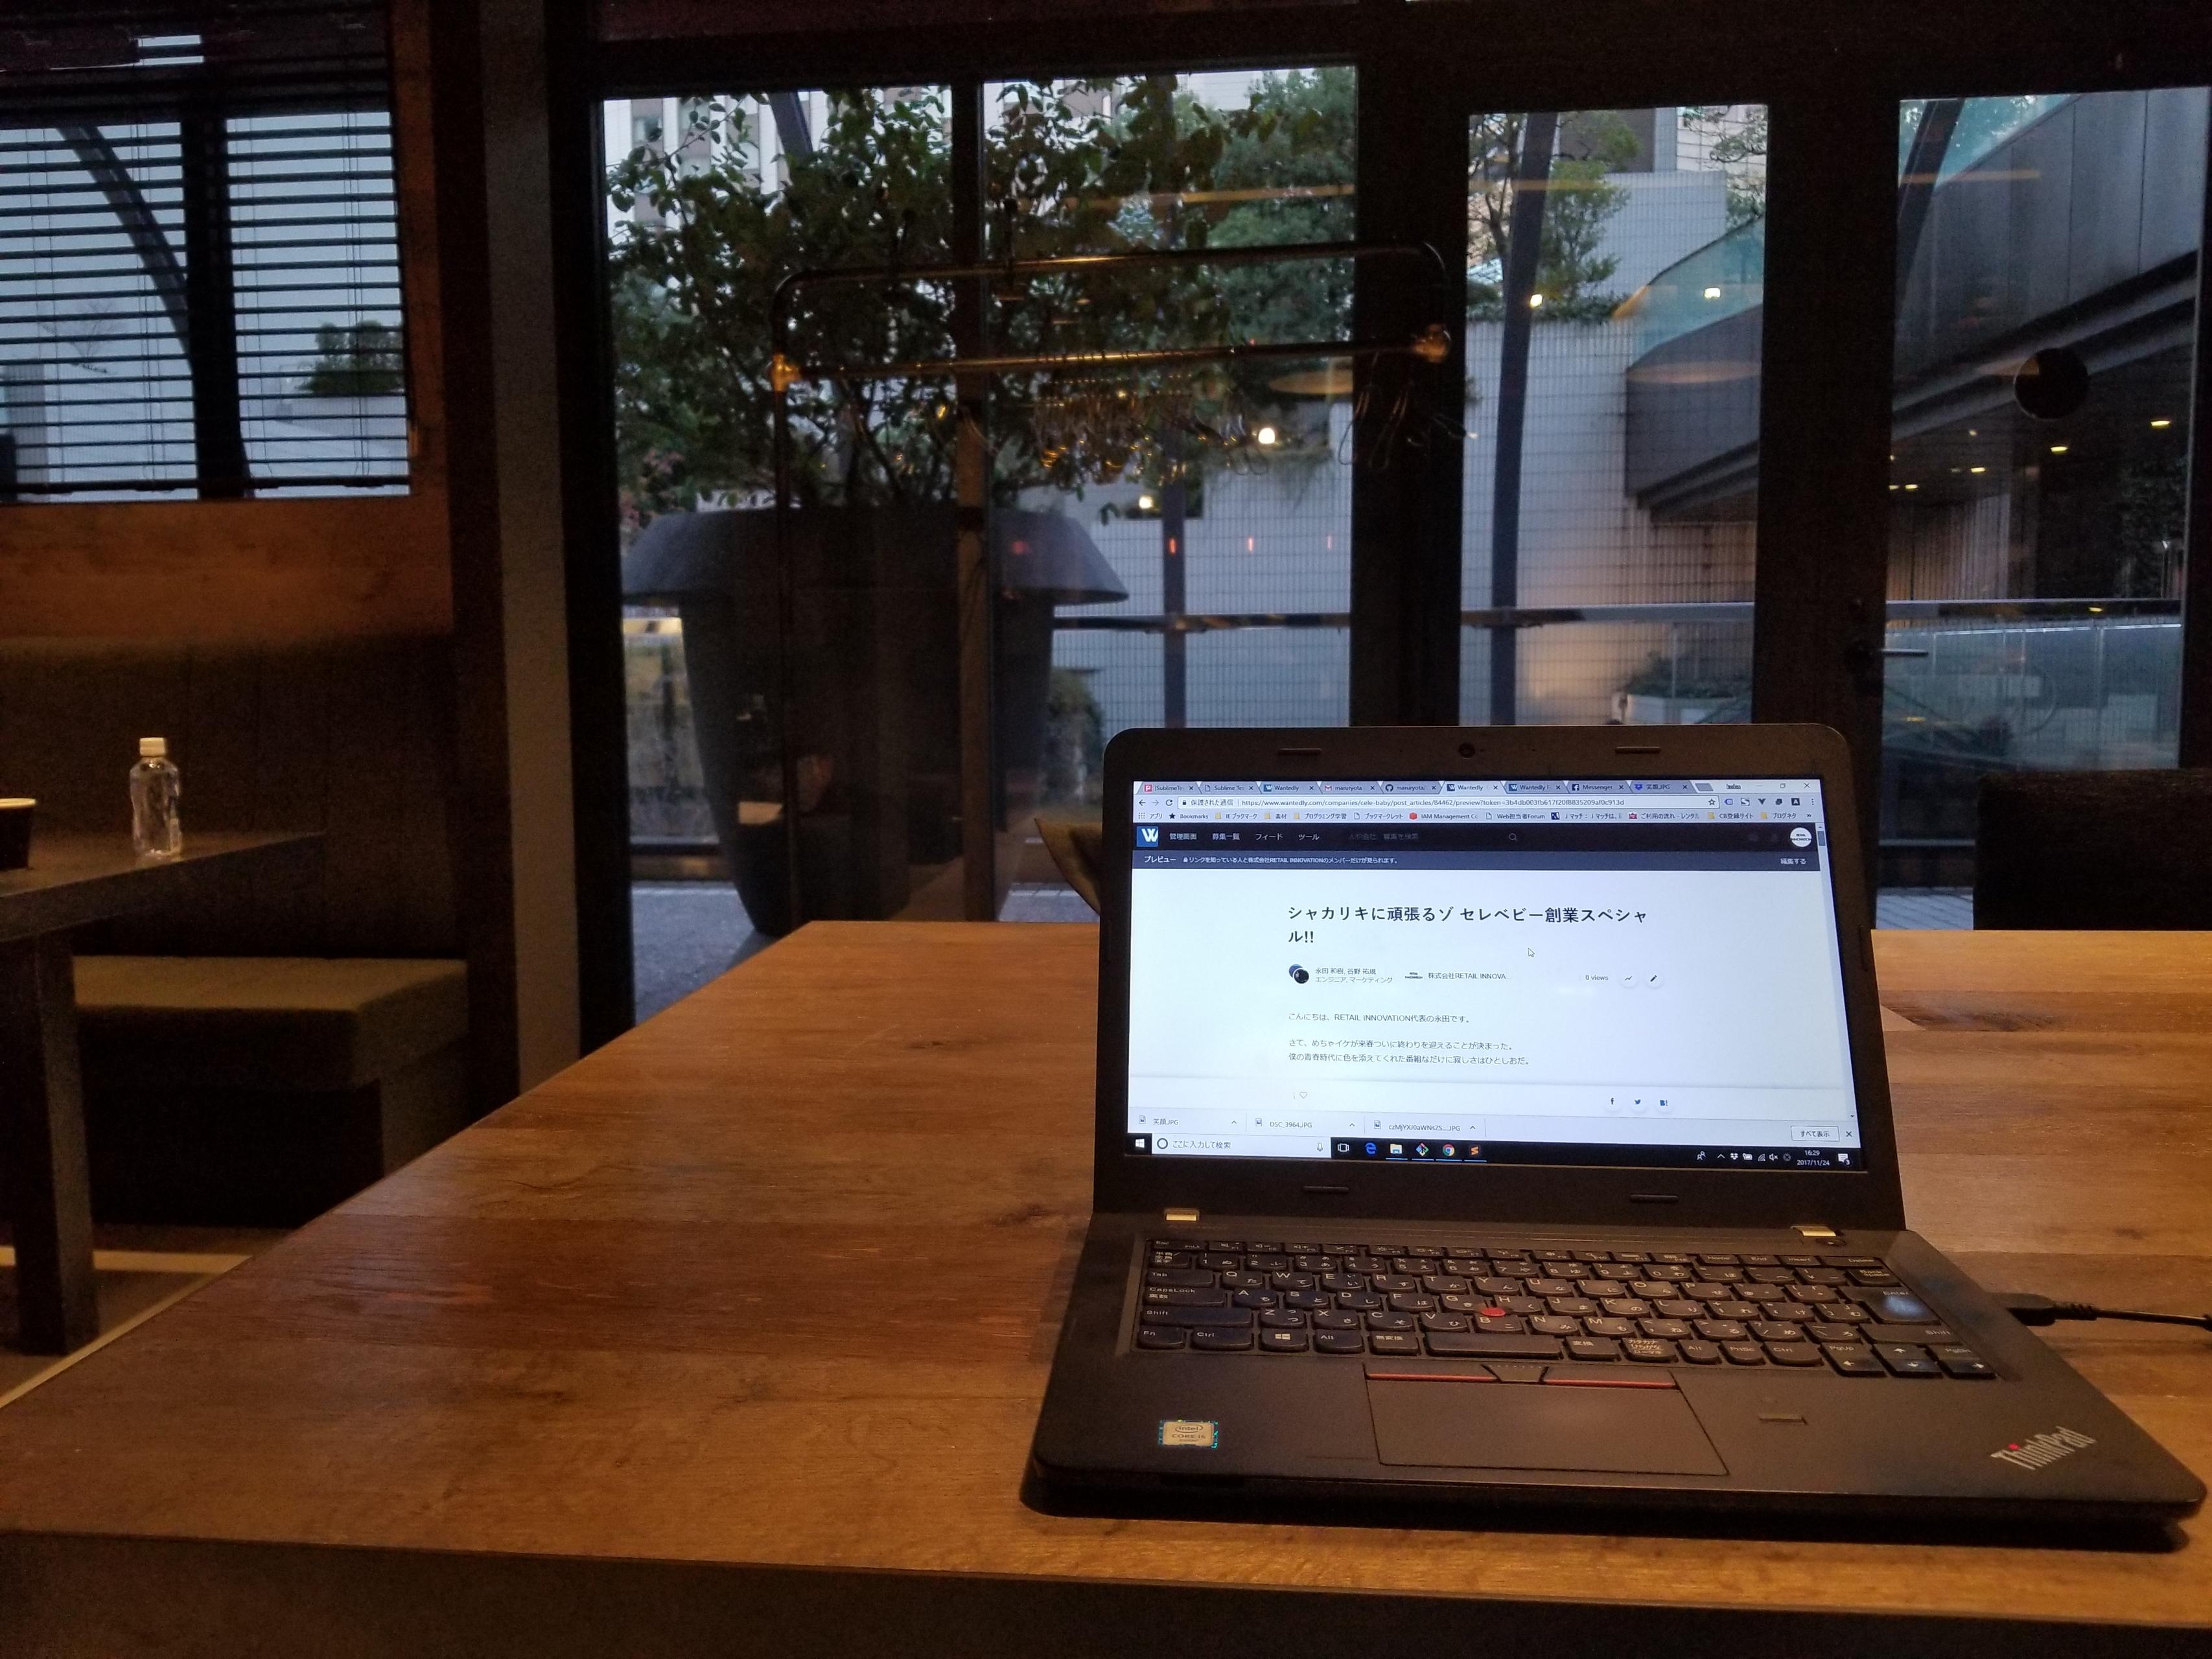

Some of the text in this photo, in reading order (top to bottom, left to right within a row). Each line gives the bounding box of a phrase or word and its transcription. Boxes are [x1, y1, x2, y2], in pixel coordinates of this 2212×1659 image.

[1288, 906, 1646, 923] シャカリキに頑張るゾ セレベビー創業スペシャ
[1363, 1014, 1469, 1023] INNOVATION代表の永田です。
[1288, 1039, 1512, 1050] さて、めちゃイケが来春ついに終わりを迎えることが決まった。
[1289, 1053, 1529, 1065] 僕の青春時代に色を添えてくれた番組なだけに寂しさはひとしおだ。
[1172, 1141, 1231, 1149] ここに入力して検索
[1990, 1426, 2097, 1470] ThinkPad
